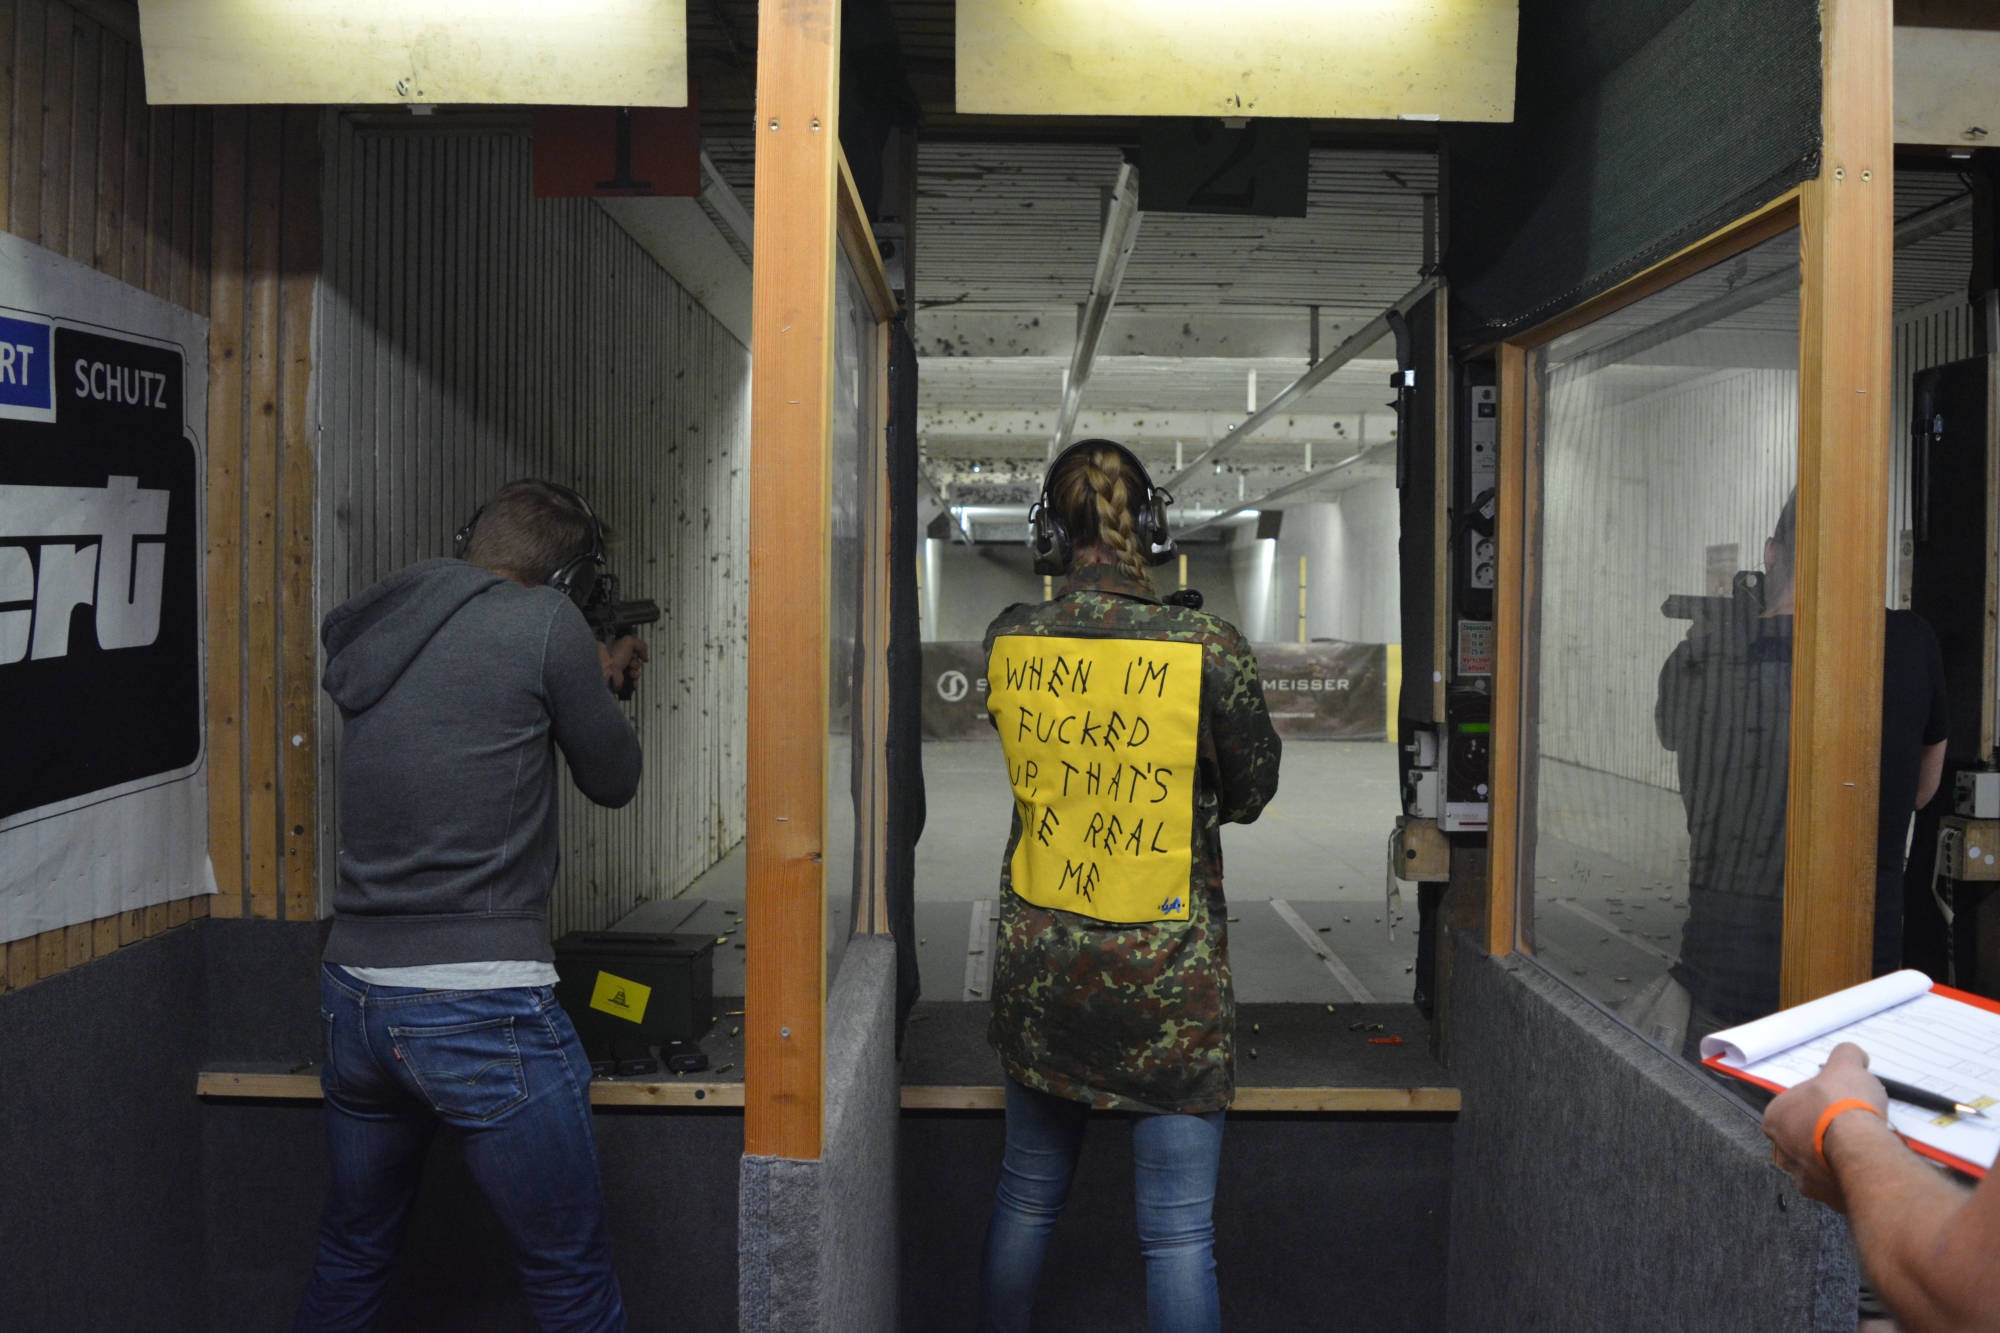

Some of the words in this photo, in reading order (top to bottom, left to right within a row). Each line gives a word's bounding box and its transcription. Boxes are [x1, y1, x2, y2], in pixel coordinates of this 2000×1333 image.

[74, 358, 168, 409] SCHUTZ
[1006, 656, 1093, 698] WHEN
[1124, 656, 1169, 698] I'M
[1018, 706, 1150, 752] FUCKED
[1060, 760, 1173, 804] THAT'S
[1083, 812, 1169, 857] REAL
[1058, 859, 1101, 903] ME
